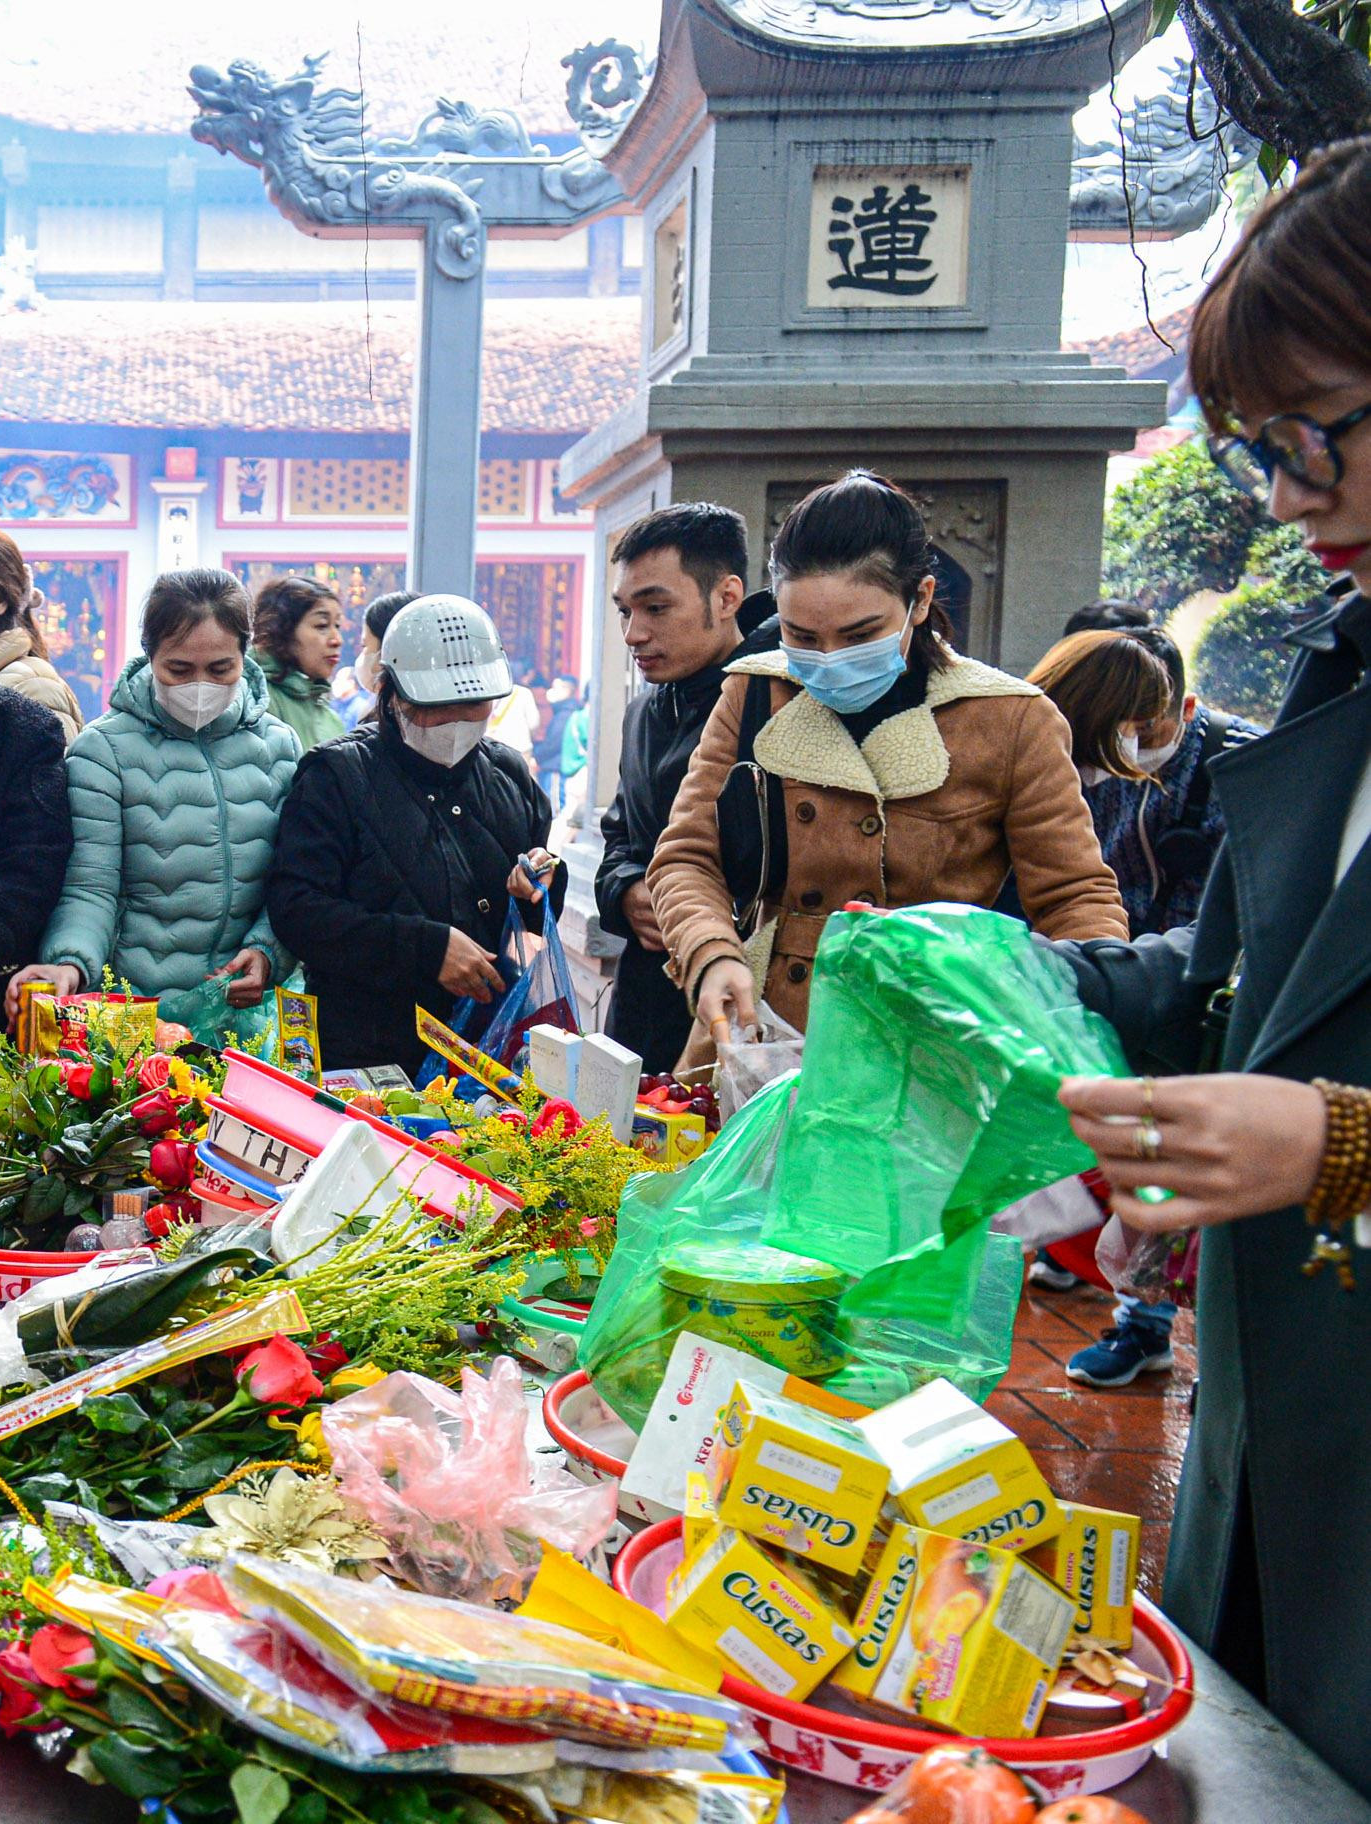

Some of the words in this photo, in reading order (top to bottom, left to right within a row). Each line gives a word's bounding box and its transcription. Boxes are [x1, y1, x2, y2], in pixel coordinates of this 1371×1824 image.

[827, 184, 940, 297] 蓮
[742, 1483, 858, 1548] Custas
[961, 1499, 1047, 1545] Custa
[721, 1570, 828, 1666] Custas
[855, 1553, 918, 1669] Custas
[1073, 1525, 1098, 1635] Custas
